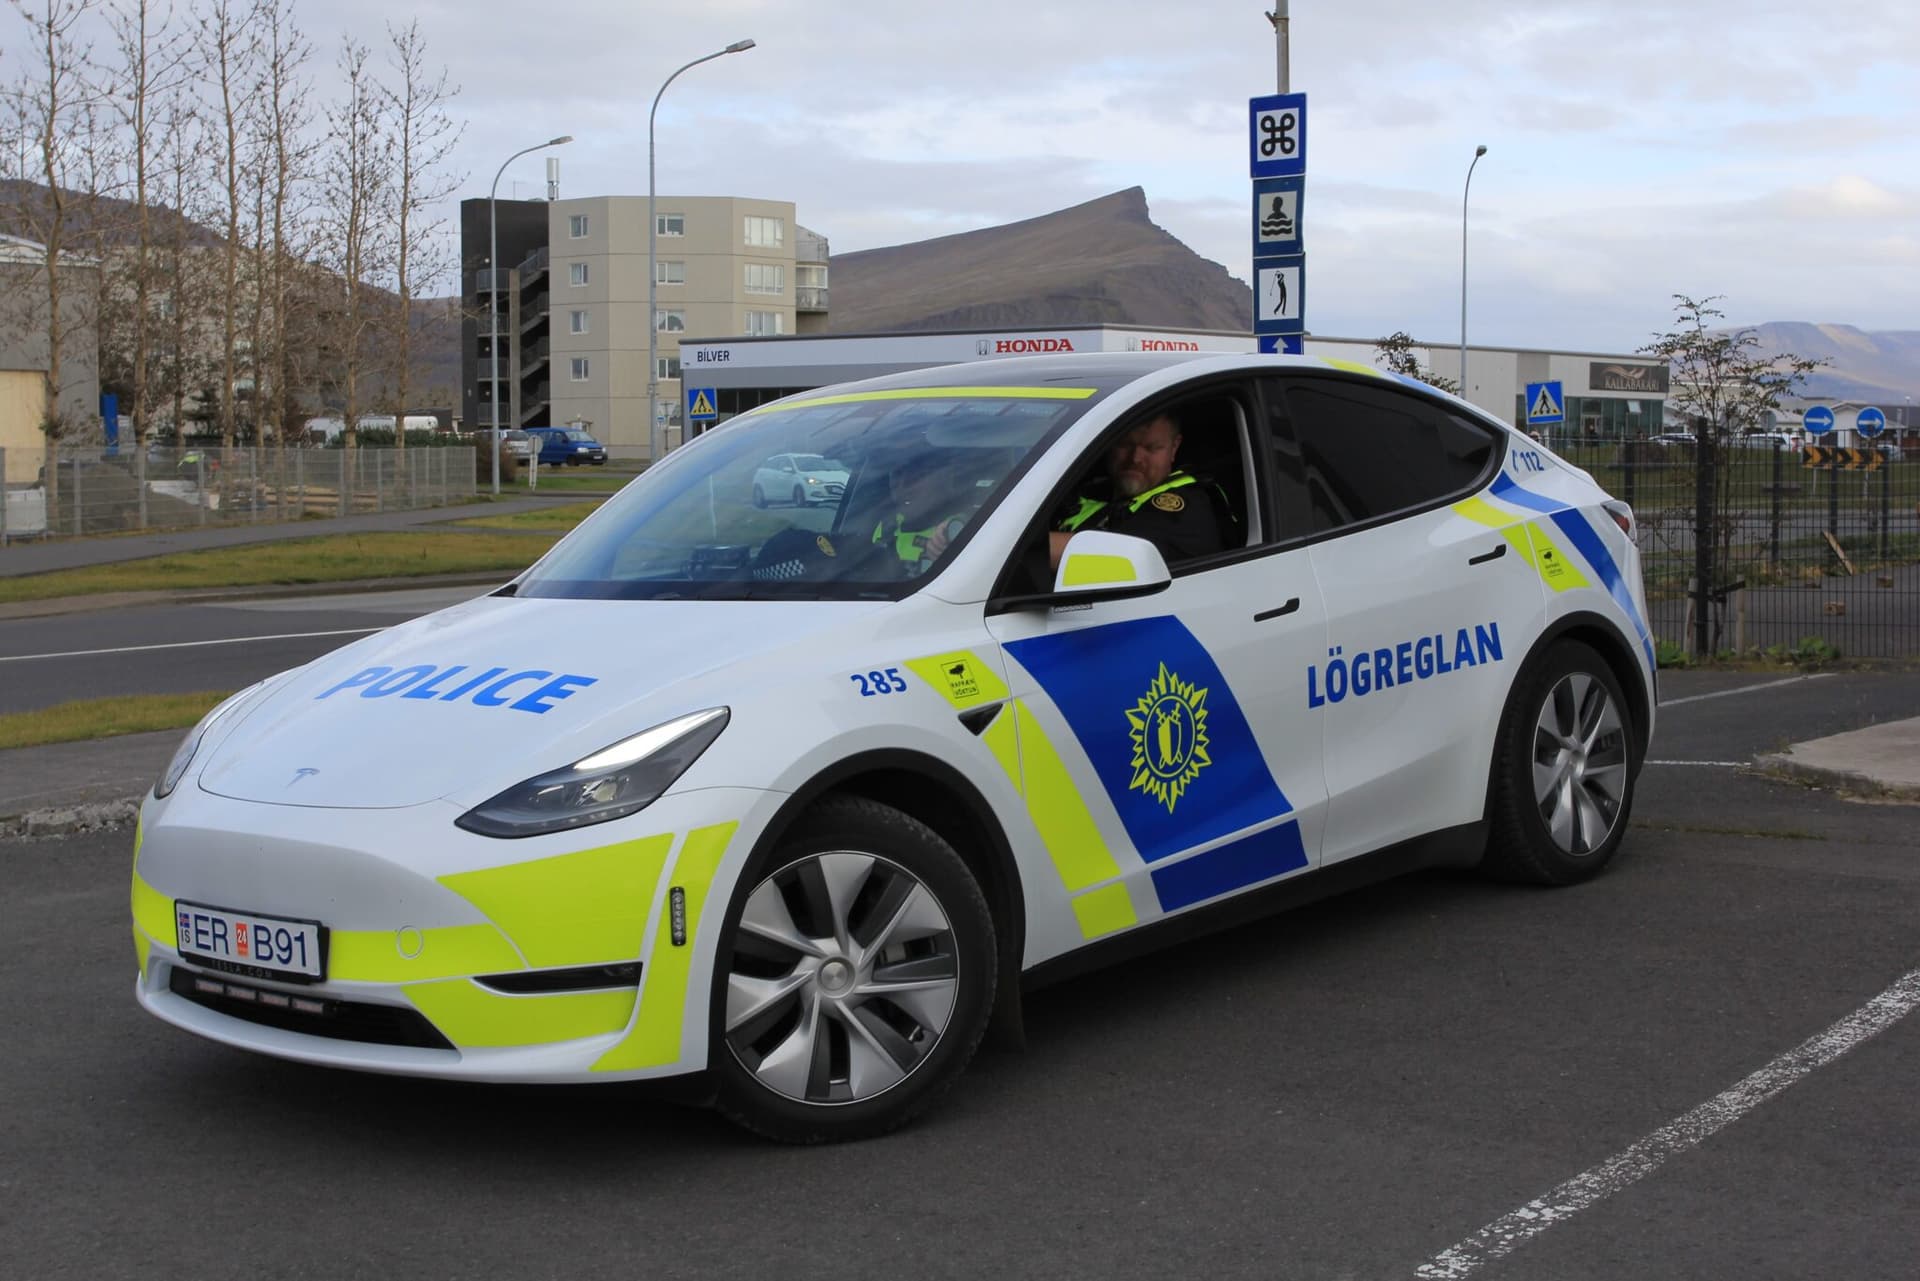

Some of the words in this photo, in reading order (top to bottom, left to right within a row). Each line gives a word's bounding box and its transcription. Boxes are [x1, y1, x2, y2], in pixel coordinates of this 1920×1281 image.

[995, 338, 1074, 353] HONDA
[1141, 339, 1199, 352] HONDA
[1519, 451, 1545, 472] 112
[1307, 621, 1504, 709] LÖGREGLAN
[314, 664, 600, 714] POLICE
[850, 667, 908, 697] 285
[180, 928, 192, 944] IS
[194, 914, 231, 955] ER
[237, 929, 248, 945] 24
[253, 924, 308, 967] B91
